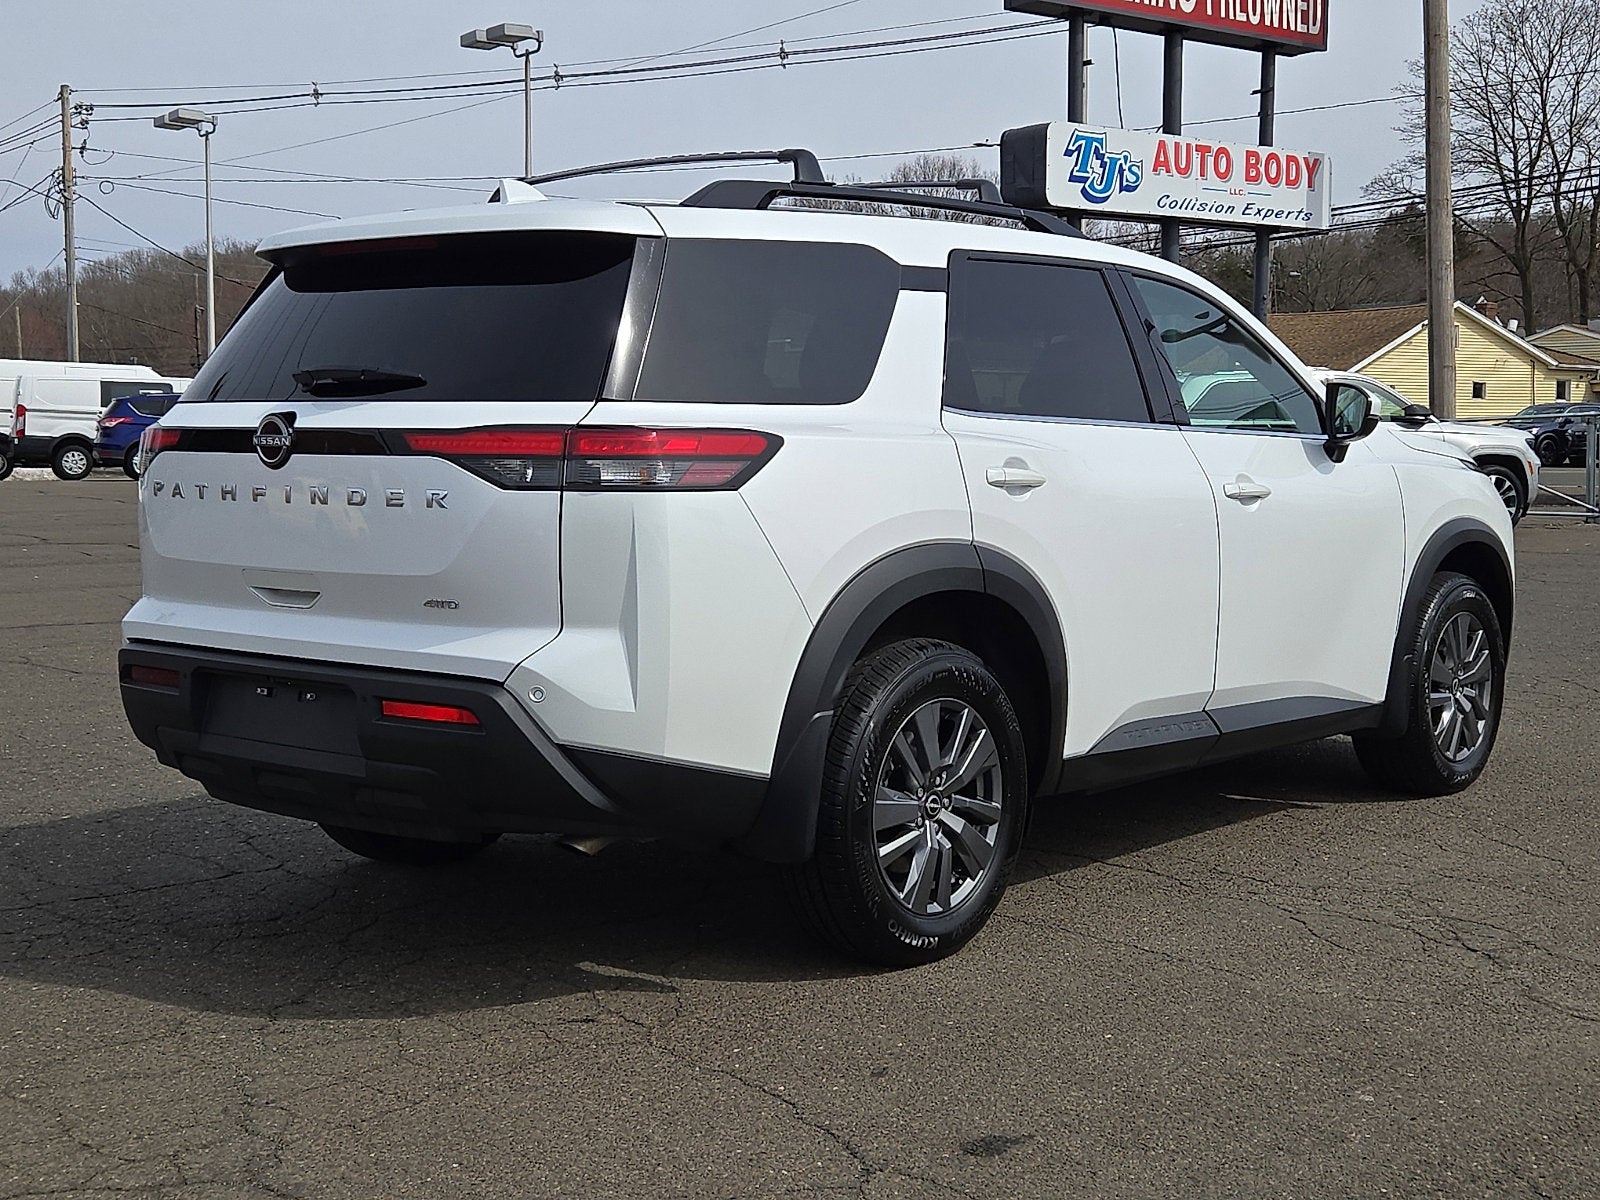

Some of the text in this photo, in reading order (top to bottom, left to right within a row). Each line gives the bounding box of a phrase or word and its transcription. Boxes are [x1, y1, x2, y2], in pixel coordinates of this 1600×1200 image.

[1152, 139, 1234, 183] AUTO
[1244, 149, 1321, 192] BODY
[1156, 194, 1313, 222] Collision Experts
[253, 435, 291, 446] NISSAN
[153, 479, 449, 510] PATHFINDER
